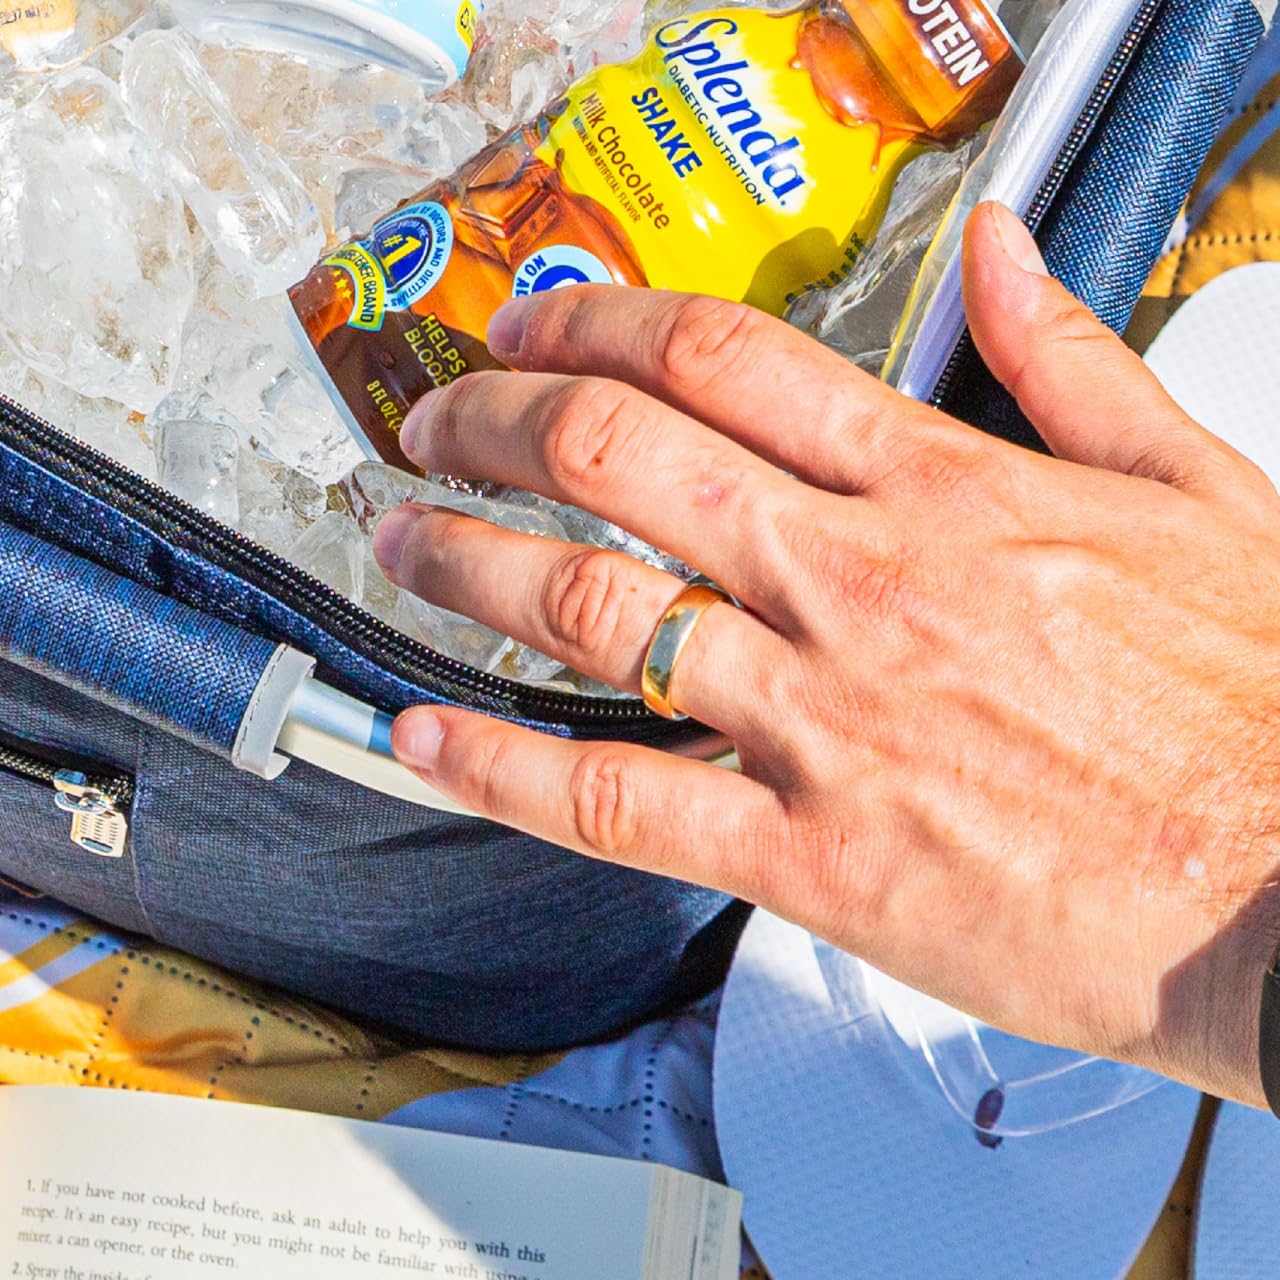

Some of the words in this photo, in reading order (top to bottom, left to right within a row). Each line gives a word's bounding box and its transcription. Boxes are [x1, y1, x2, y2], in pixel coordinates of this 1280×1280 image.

[631, 87, 704, 179] SHAKE
[655, 18, 806, 199] Splenda
[668, 64, 710, 125] DIABETIC
[705, 125, 766, 206] NUTRITION
[578, 92, 608, 130] Milk
[597, 125, 670, 230] Chocolate
[593, 153, 620, 194] ARTIFICIAL
[617, 191, 641, 224] FLAVOR
[381, 234, 422, 276] #1
[430, 247, 444, 267] AND
[524, 254, 547, 276] NO
[360, 280, 377, 323] BRAND
[404, 327, 453, 387] BLOOD
[420, 314, 467, 375] HELPS
[366, 379, 375, 392] 8
[17, 1230, 52, 1244] mixer,
[67, 1236, 90, 1249] can
[93, 1238, 146, 1257] opener,
[150, 1245, 166, 1258] or
[171, 1243, 195, 1262] the
[199, 1252, 239, 1269] oven.
[21, 1204, 58, 1220] recipe.
[89, 1212, 105, 1225] an
[110, 1216, 140, 1232] easy
[147, 1220, 195, 1239] recipe,
[201, 1223, 227, 1240] but
[232, 1231, 262, 1247] you
[268, 1235, 312, 1255] might
[320, 1244, 345, 1260] not
[352, 1245, 371, 1263] be
[377, 1250, 436, 1273] familiar
[444, 1261, 479, 1280] with
[41, 1178, 53, 1194] If
[55, 1183, 79, 1199] you
[85, 1183, 116, 1200] have
[121, 1190, 146, 1204] not
[152, 1194, 206, 1212] cooked
[212, 1199, 265, 1221] before,
[271, 1209, 296, 1225] ask
[303, 1216, 321, 1230] an
[328, 1218, 367, 1237] adult
[375, 1227, 391, 1240] to
[398, 1226, 431, 1247] help
[438, 1237, 468, 1253] you
[474, 1240, 510, 1260] with
[516, 1244, 546, 1264] this
